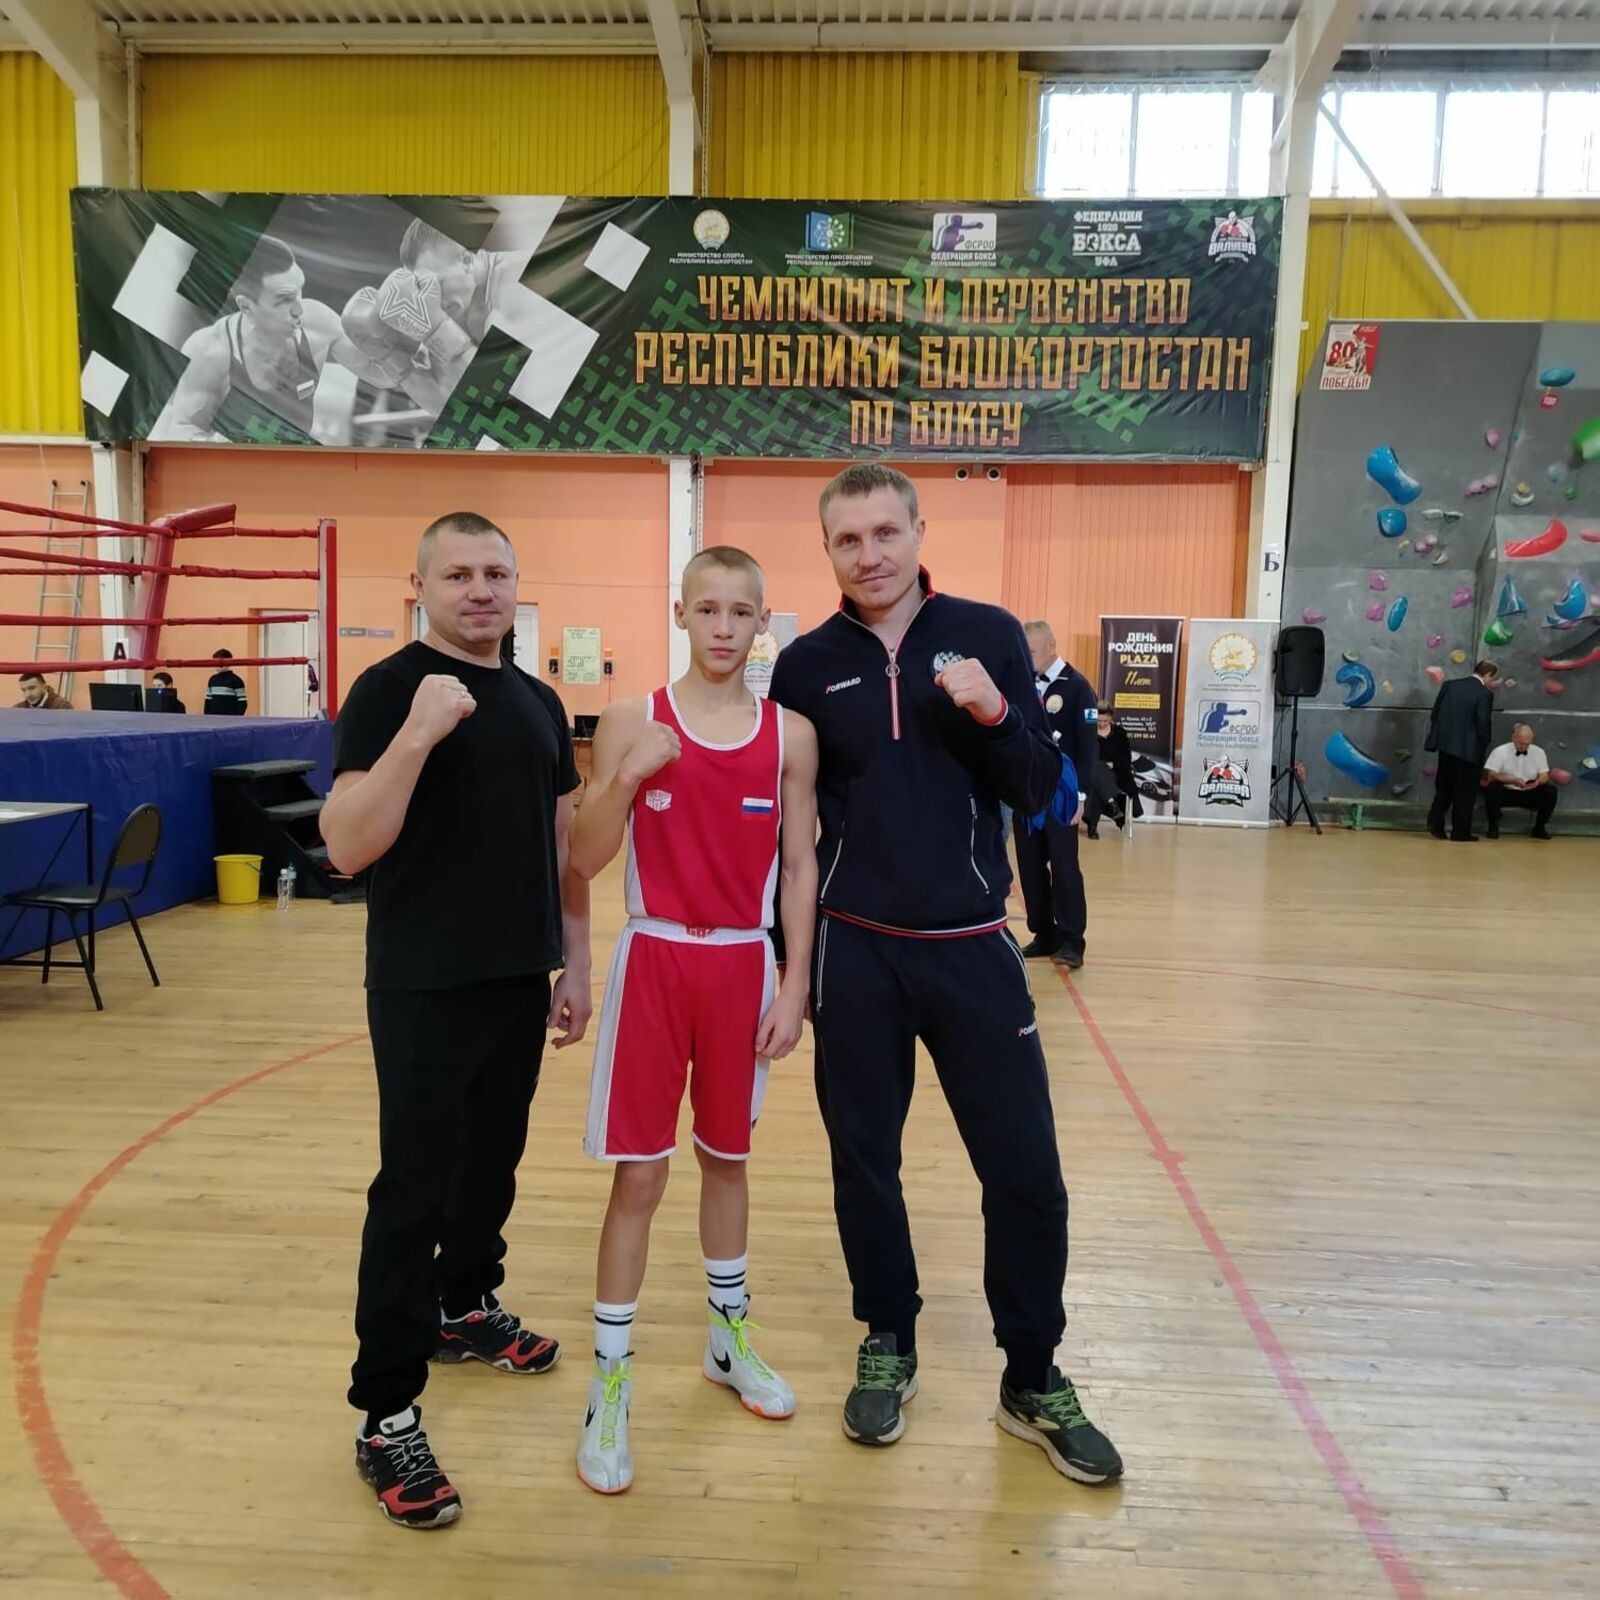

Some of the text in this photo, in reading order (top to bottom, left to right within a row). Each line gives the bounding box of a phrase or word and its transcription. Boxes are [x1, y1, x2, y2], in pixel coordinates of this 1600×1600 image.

[1074, 210, 1143, 223] ФЕДЕРАЦИЯ
[1073, 232, 1141, 251] БОКСА
[931, 252, 996, 261] ФЕДЕРАЦИЯ БОКСА
[697, 276, 1191, 324] ЧЕМПИОНАТ И ПЕРВЕНСТВО
[634, 331, 1251, 391] РЕСПУБЛИКИ БАШКОРТОСТАН
[1327, 341, 1356, 366] 80
[851, 400, 1023, 446] ПО БОКСУ
[1264, 552, 1280, 572] Б
[1126, 632, 1157, 643] ДЕНЬ
[1108, 642, 1173, 654] РОЖДЕНИЯ
[1120, 654, 1159, 665] PLAZA
